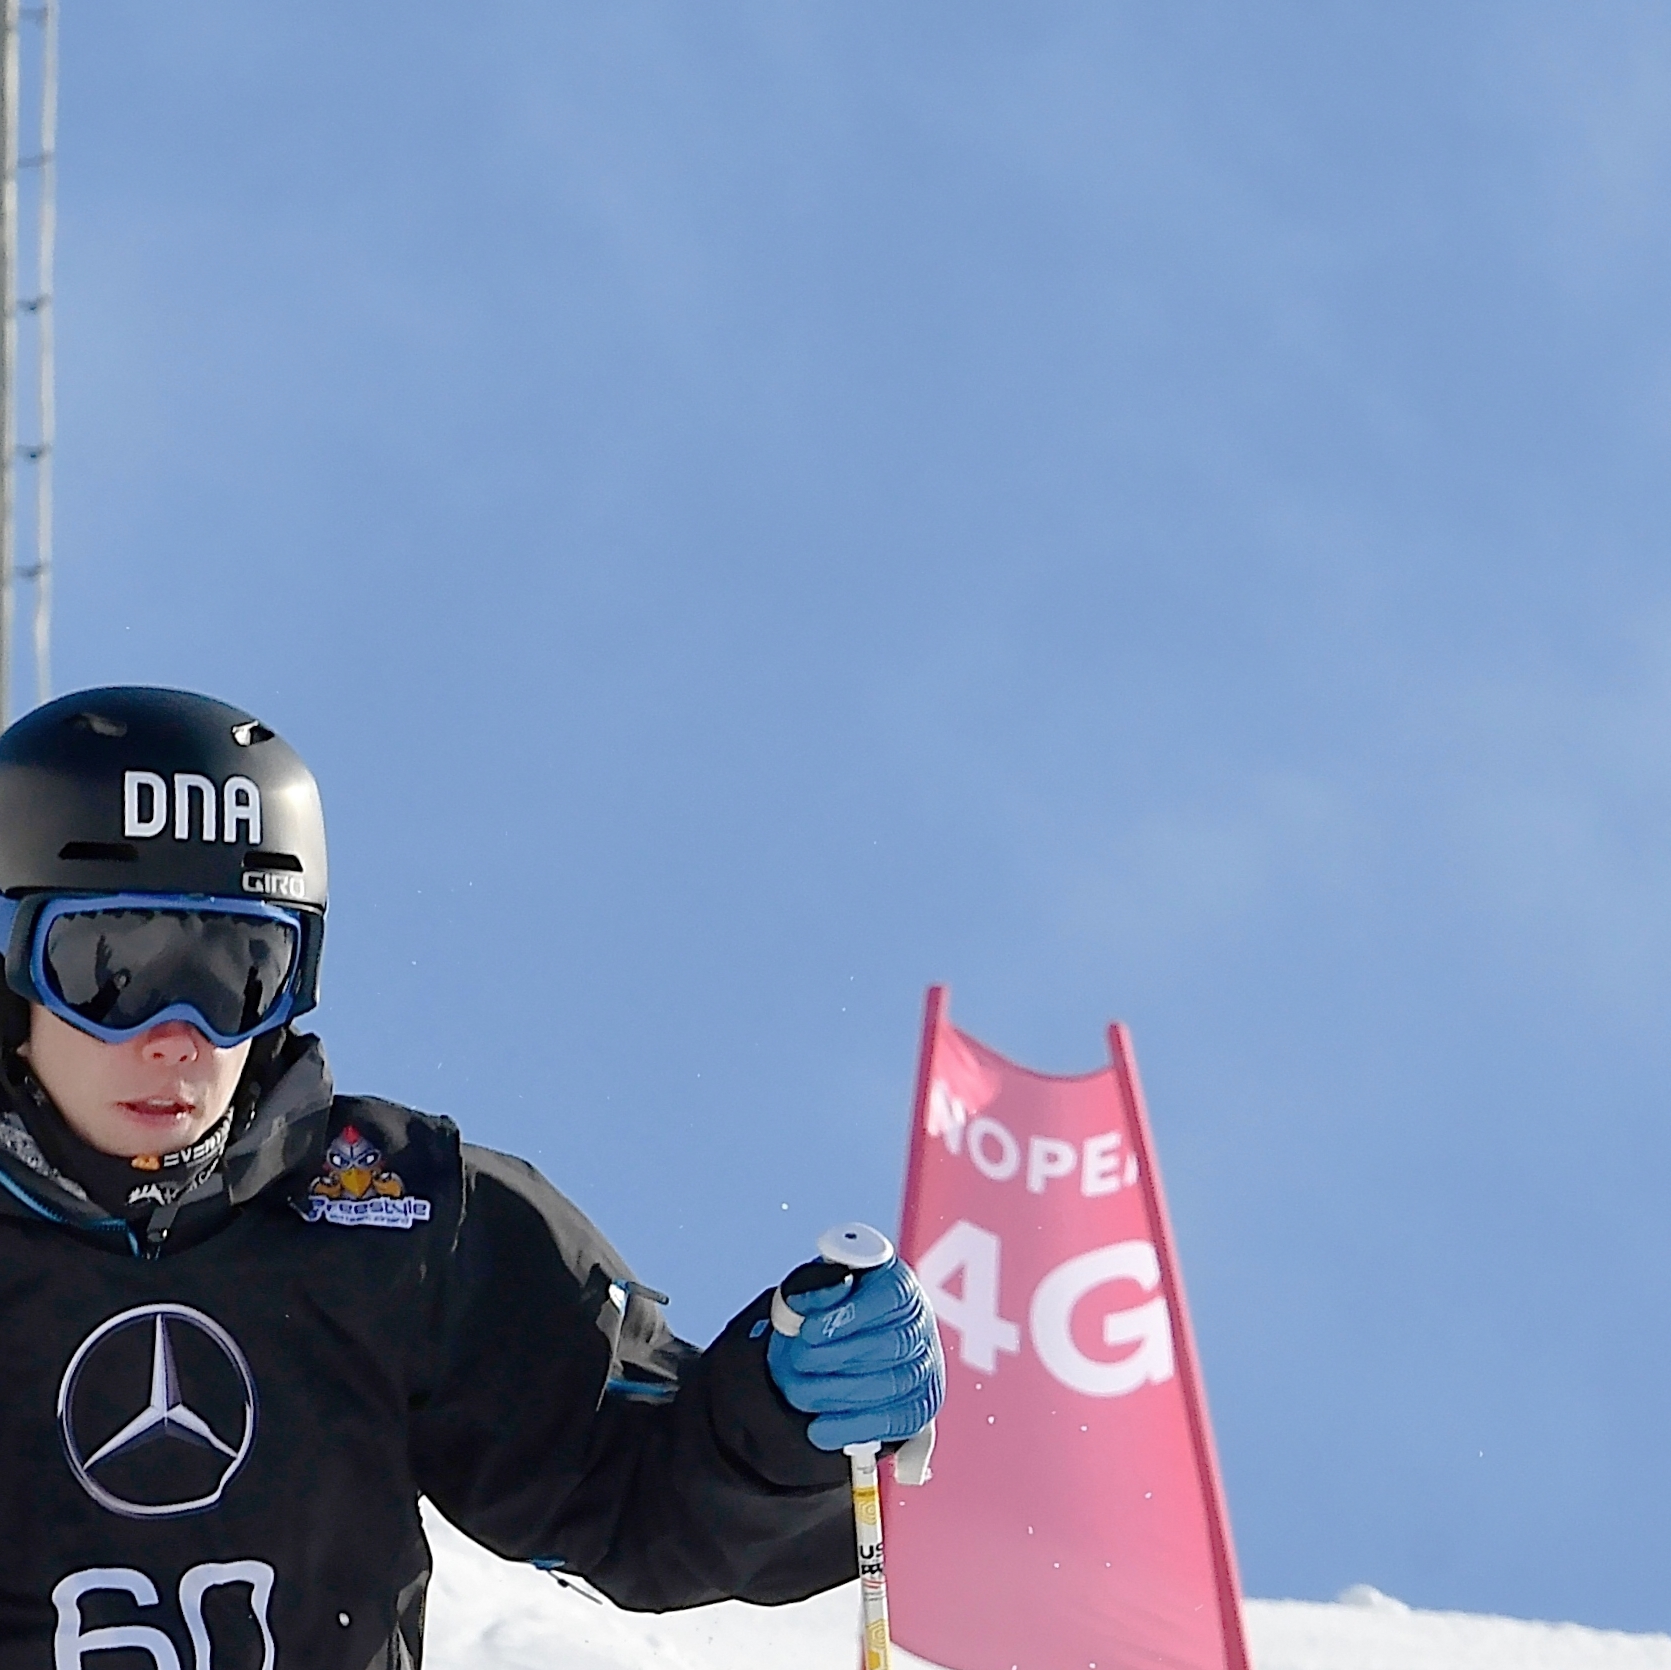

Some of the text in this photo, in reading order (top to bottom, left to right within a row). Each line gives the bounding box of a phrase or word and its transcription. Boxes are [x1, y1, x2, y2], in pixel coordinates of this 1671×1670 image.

[124, 770, 263, 845] DNA
[241, 870, 305, 898] GIRO
[916, 1218, 1176, 1397] 4G
